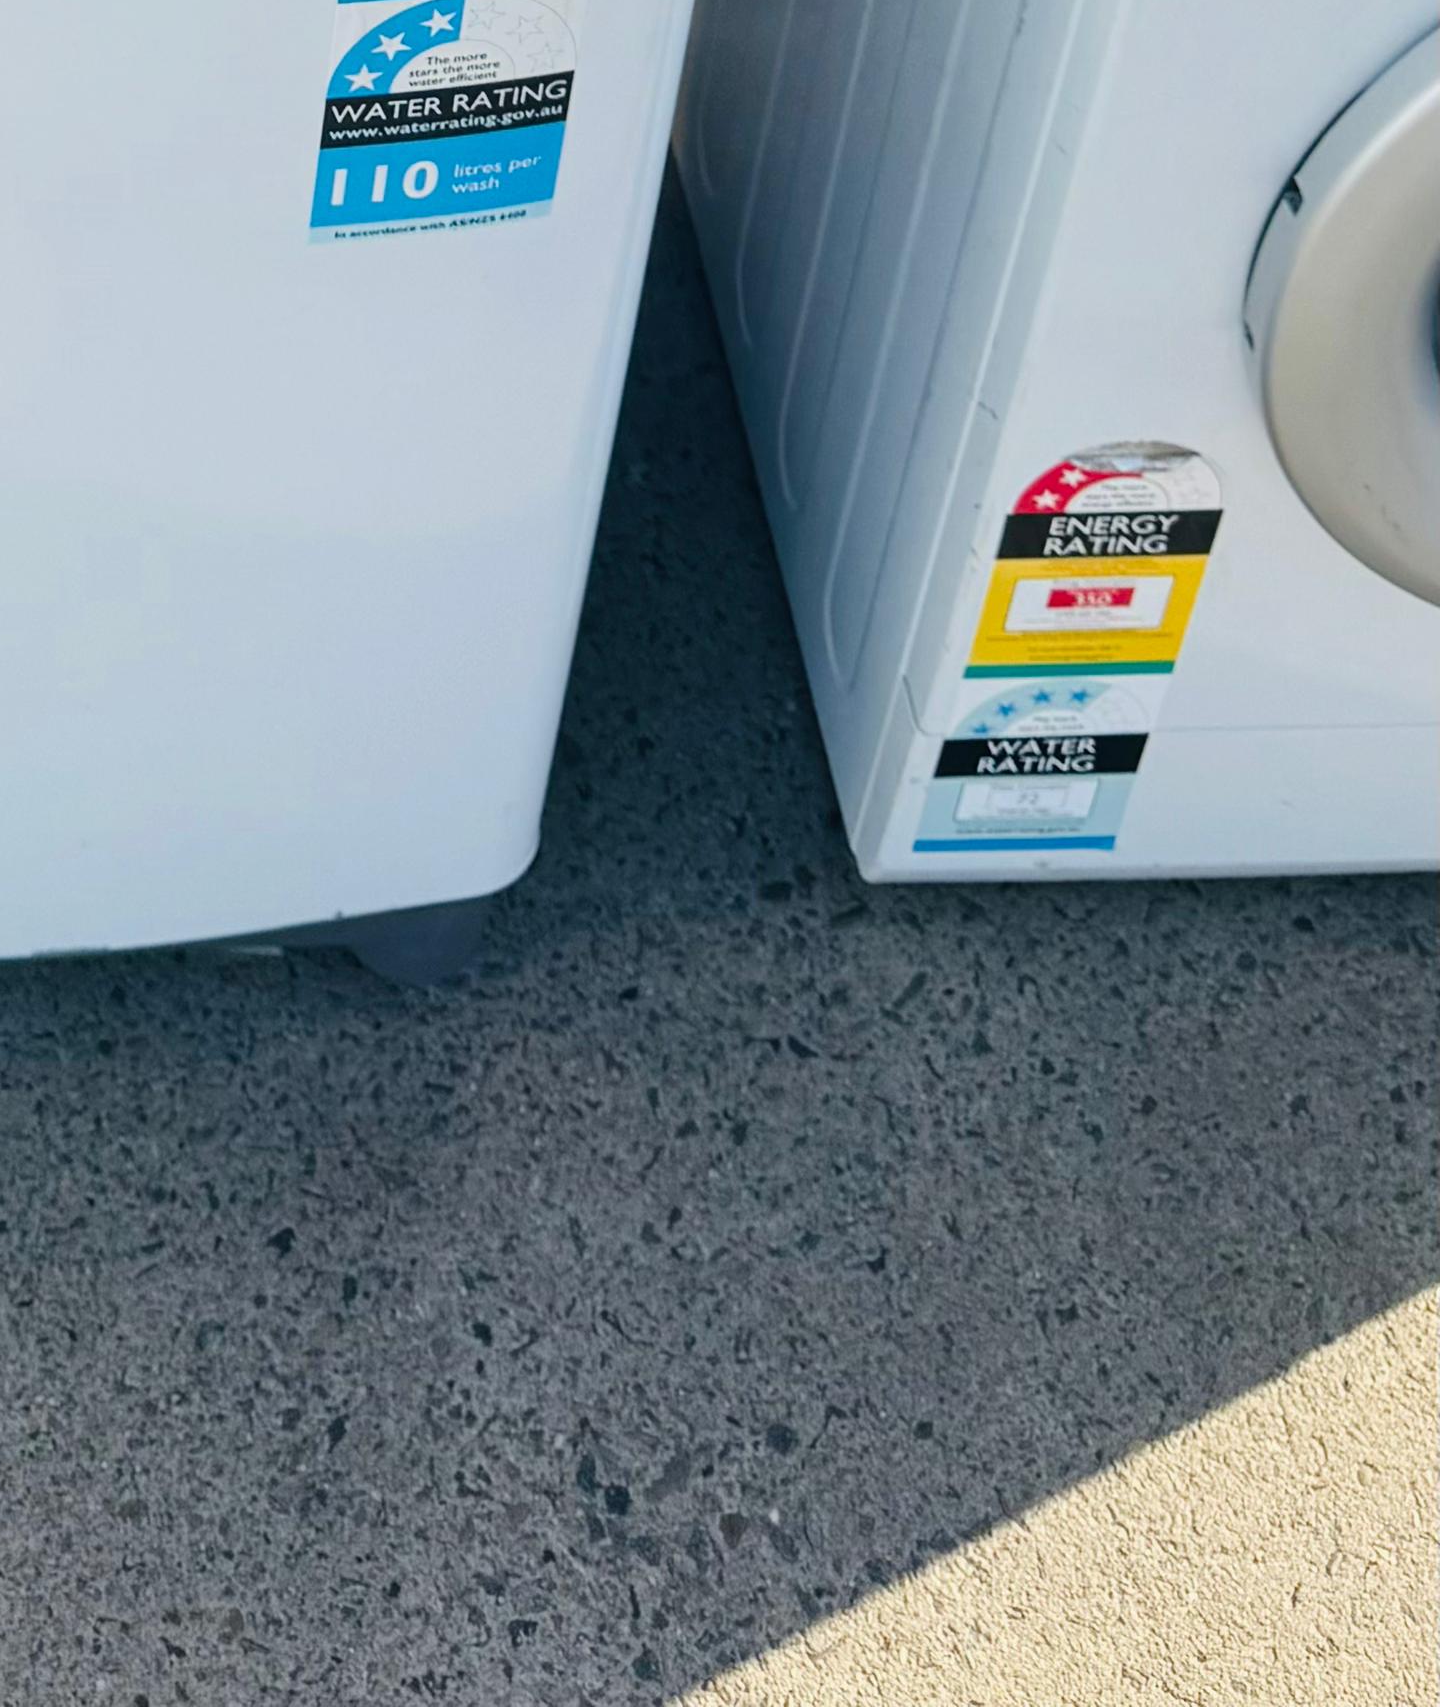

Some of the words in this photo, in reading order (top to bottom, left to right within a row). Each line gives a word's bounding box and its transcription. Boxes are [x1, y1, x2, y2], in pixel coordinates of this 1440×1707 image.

[427, 56, 449, 65] The
[453, 53, 488, 63] more
[409, 68, 438, 78] stars
[443, 66, 463, 74] the
[467, 62, 500, 71] more
[409, 77, 446, 87] water
[449, 71, 497, 83] efficient
[331, 98, 442, 123] WATER
[452, 79, 568, 113] RATING
[329, 104, 563, 140] www.waterrating.gov.au
[453, 161, 502, 178] litres
[508, 156, 542, 173] per
[451, 176, 500, 194] wash
[1048, 513, 1180, 536] ENERGY
[1042, 533, 1170, 557] RATING
[987, 737, 1097, 756] WATER
[976, 755, 1096, 774] RATING
